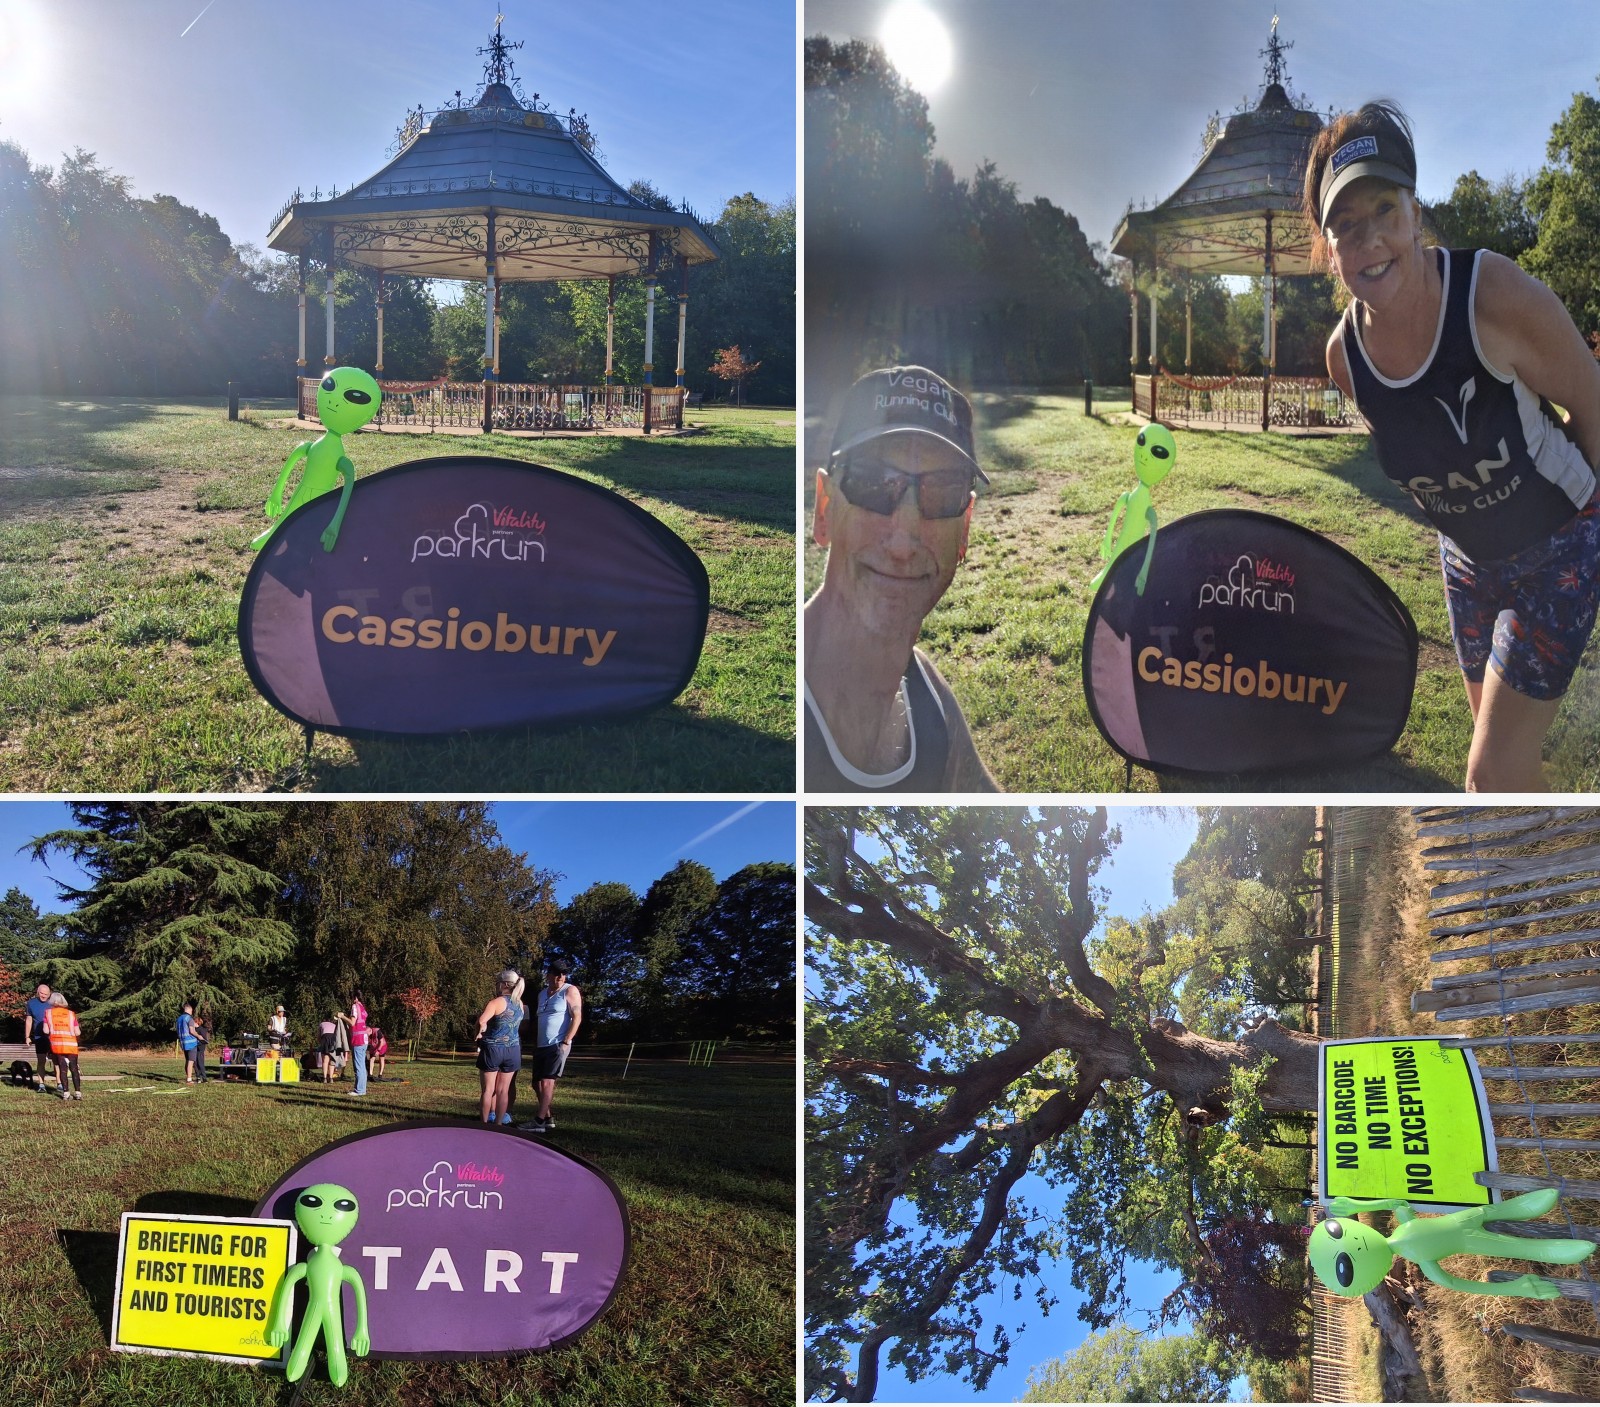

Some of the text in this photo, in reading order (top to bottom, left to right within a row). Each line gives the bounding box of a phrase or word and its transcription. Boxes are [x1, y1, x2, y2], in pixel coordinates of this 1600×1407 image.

[1334, 139, 1373, 162] VEGAN
[874, 393, 929, 411] Running
[888, 373, 952, 402] Vegan
[1398, 437, 1511, 491] GAN
[411, 504, 545, 562] parkrun
[493, 505, 546, 535] Vitality
[1199, 555, 1295, 614] parkrun
[1256, 557, 1295, 588] Vitality
[321, 605, 618, 667] Cassiobury
[1137, 646, 1348, 715] Cassiobury
[1334, 1059, 1359, 1169] NO BARCODE
[1364, 1075, 1392, 1150] NO TIME
[1392, 1046, 1434, 1195] NO EXCEPTIONS!
[386, 1160, 503, 1212] parkrun
[457, 1161, 505, 1188] Vitality
[138, 1230, 267, 1258] BRIEFING FOR
[136, 1260, 265, 1289] FIRST TIMERS
[340, 1246, 579, 1294] TART
[130, 1289, 267, 1321] AND TOURISTS
